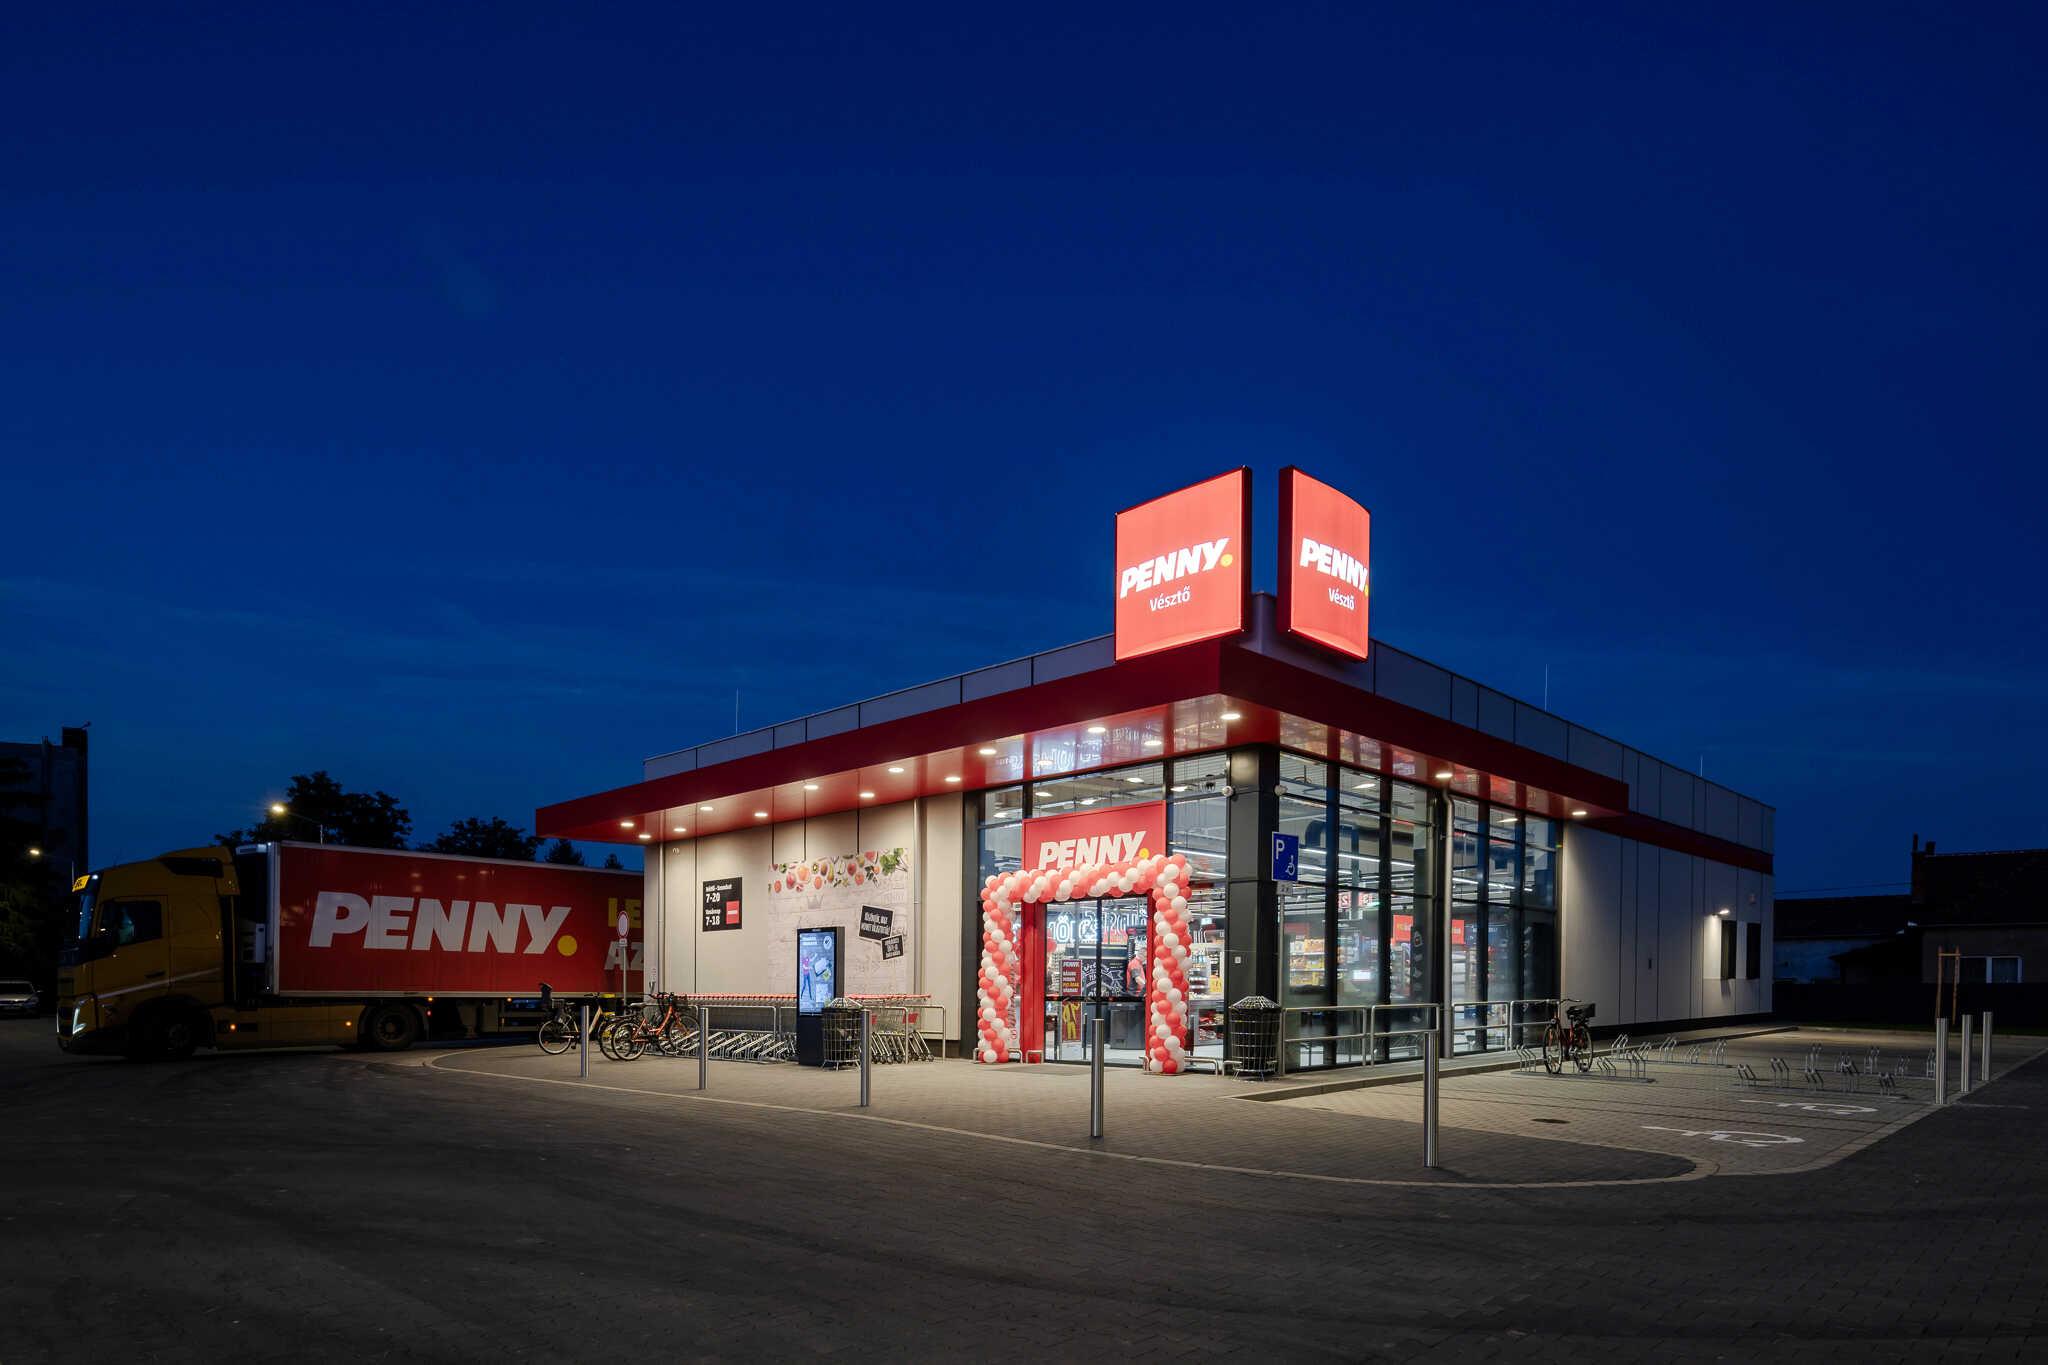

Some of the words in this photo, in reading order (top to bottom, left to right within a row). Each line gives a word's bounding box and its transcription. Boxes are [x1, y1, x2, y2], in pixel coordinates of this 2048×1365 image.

[1149, 585, 1191, 612] Vésztő
[1328, 587, 1355, 611] Vésztő
[1276, 839, 1285, 860] P
